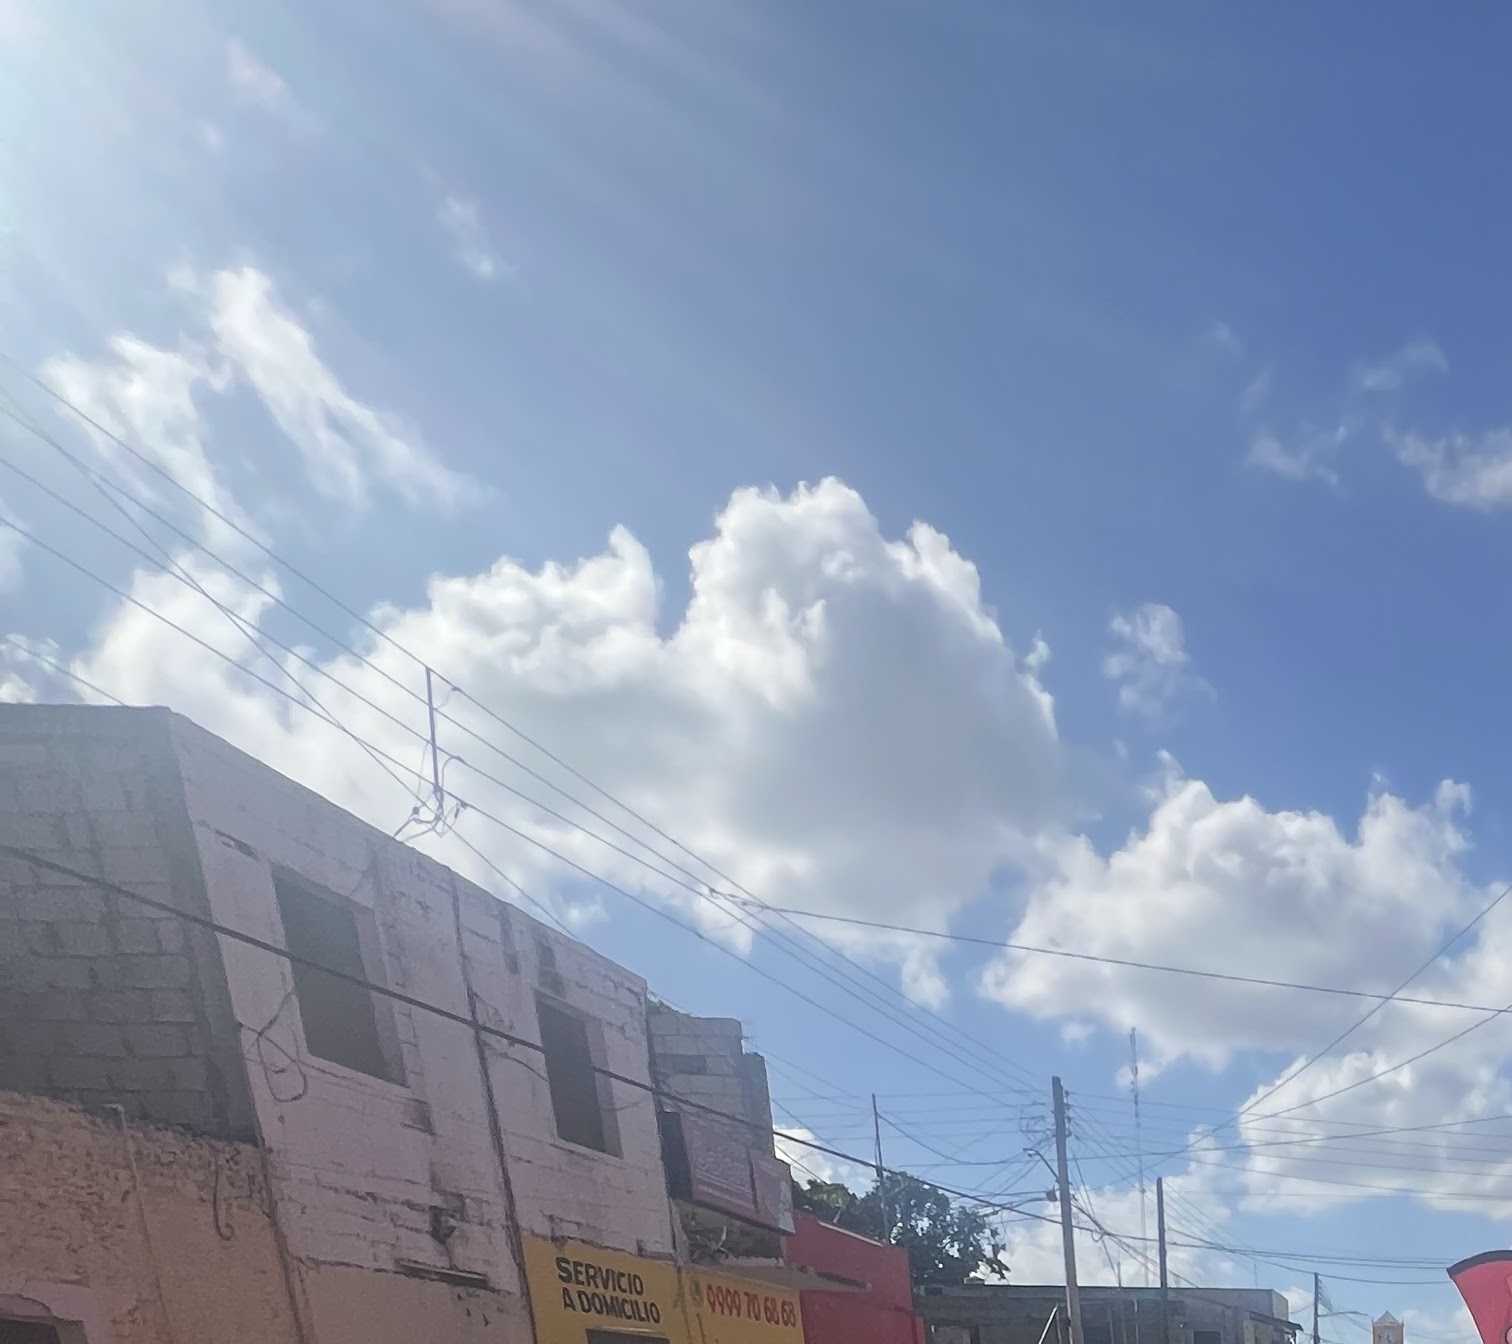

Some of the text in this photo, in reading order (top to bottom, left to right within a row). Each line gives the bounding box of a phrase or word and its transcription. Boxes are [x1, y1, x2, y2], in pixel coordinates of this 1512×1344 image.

[556, 1256, 644, 1296] SERVICIO
[562, 1287, 661, 1324] A DOMICILIO
[706, 1283, 741, 1318] 9999
[743, 1291, 760, 1322] 70
